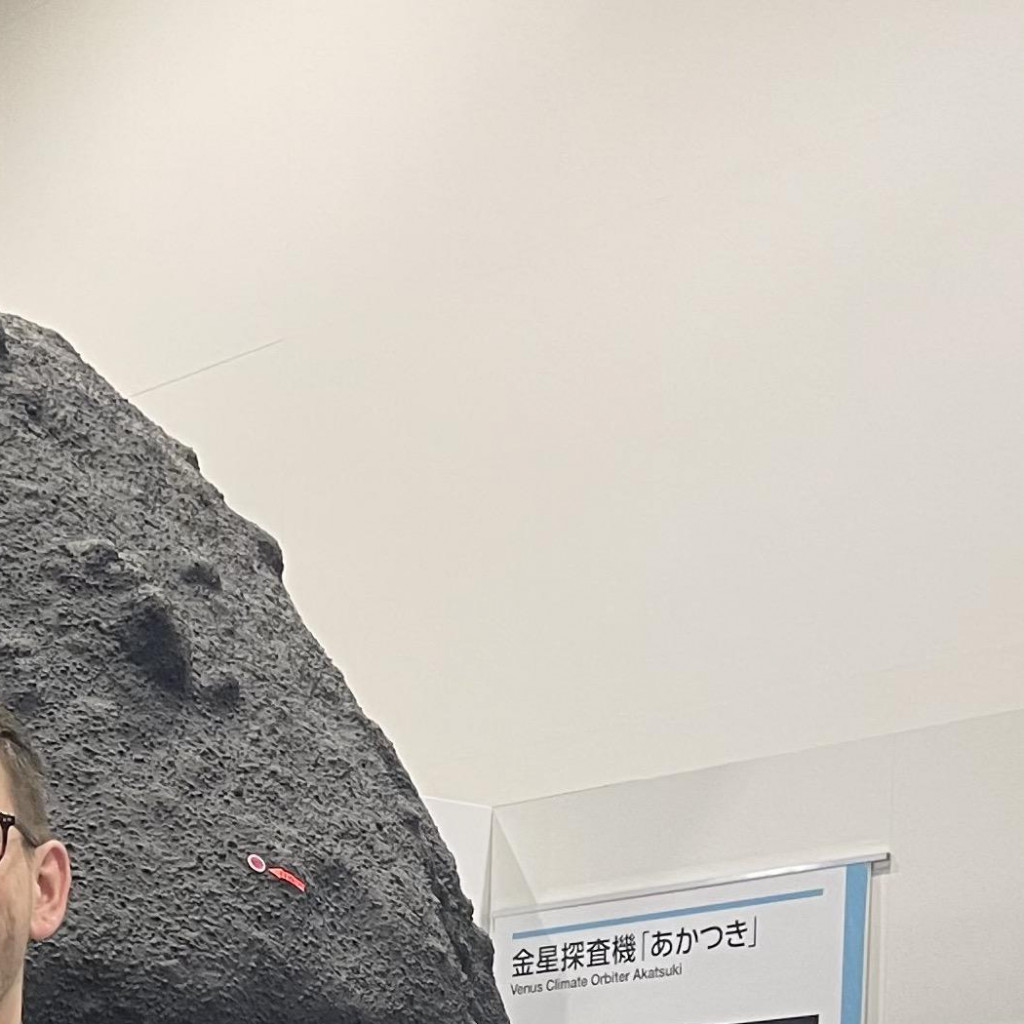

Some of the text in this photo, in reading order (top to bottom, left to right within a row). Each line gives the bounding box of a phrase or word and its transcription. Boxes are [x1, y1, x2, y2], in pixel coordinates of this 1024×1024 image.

[512, 916, 757, 978] 金星探査機「あかつき」
[510, 963, 682, 996] Venus Climate Orbiter Akatsuki
